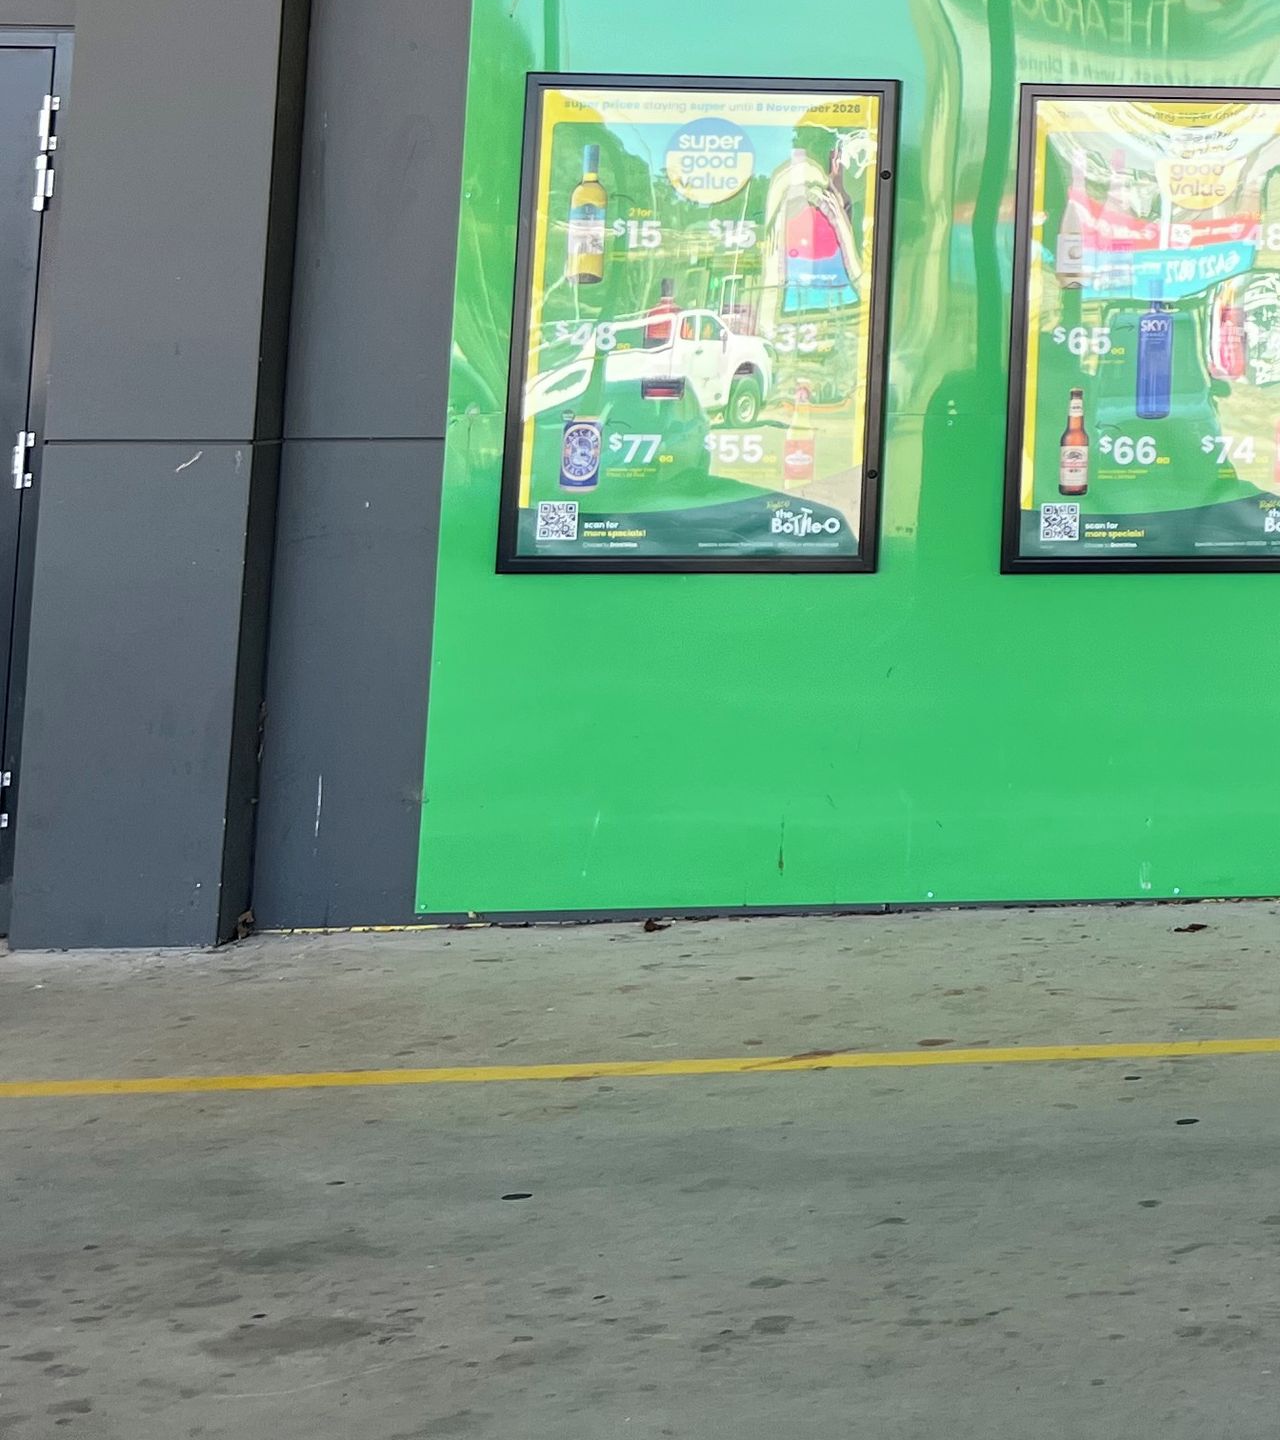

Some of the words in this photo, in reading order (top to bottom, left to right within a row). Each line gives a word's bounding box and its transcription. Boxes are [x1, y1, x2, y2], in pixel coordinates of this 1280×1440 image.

[679, 133, 743, 152] super
[681, 150, 738, 173] good
[681, 172, 739, 190] value
[613, 218, 662, 248] $15
[1140, 319, 1170, 332] SKYY
[1053, 326, 1112, 356] $65
[609, 432, 662, 464] $77
[704, 433, 764, 464] $55
[1099, 434, 1157, 465] $66
[1201, 434, 1257, 465] $74
[583, 522, 605, 530] scan
[606, 521, 619, 529] for
[771, 507, 841, 537] Bottle-O
[775, 509, 793, 519] the
[1085, 522, 1106, 530] scan
[1106, 522, 1118, 530] for
